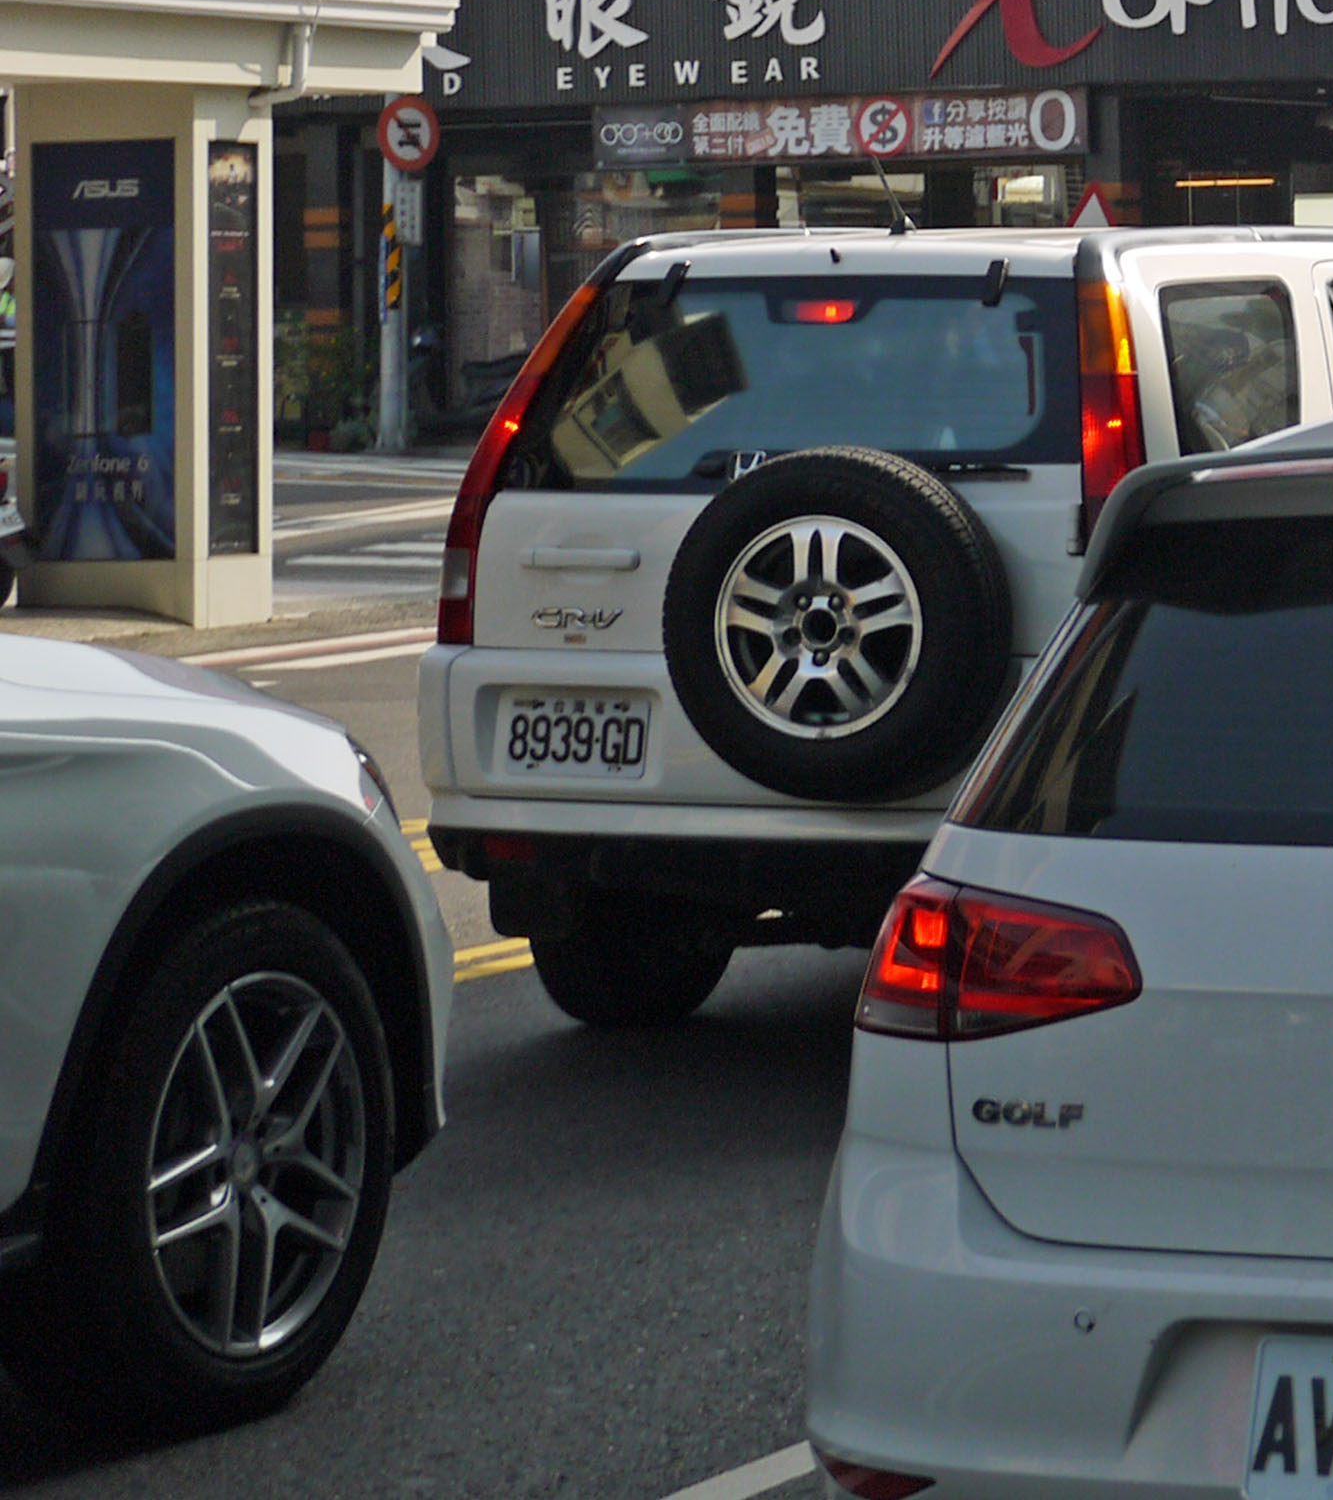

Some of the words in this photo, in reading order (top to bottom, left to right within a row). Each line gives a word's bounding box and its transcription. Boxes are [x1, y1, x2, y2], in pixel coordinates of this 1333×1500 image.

[766, 103, 852, 157] 免費
[73, 179, 140, 200] ASUS
[137, 455, 150, 472] 6
[972, 1098, 1085, 1129] GOLF
